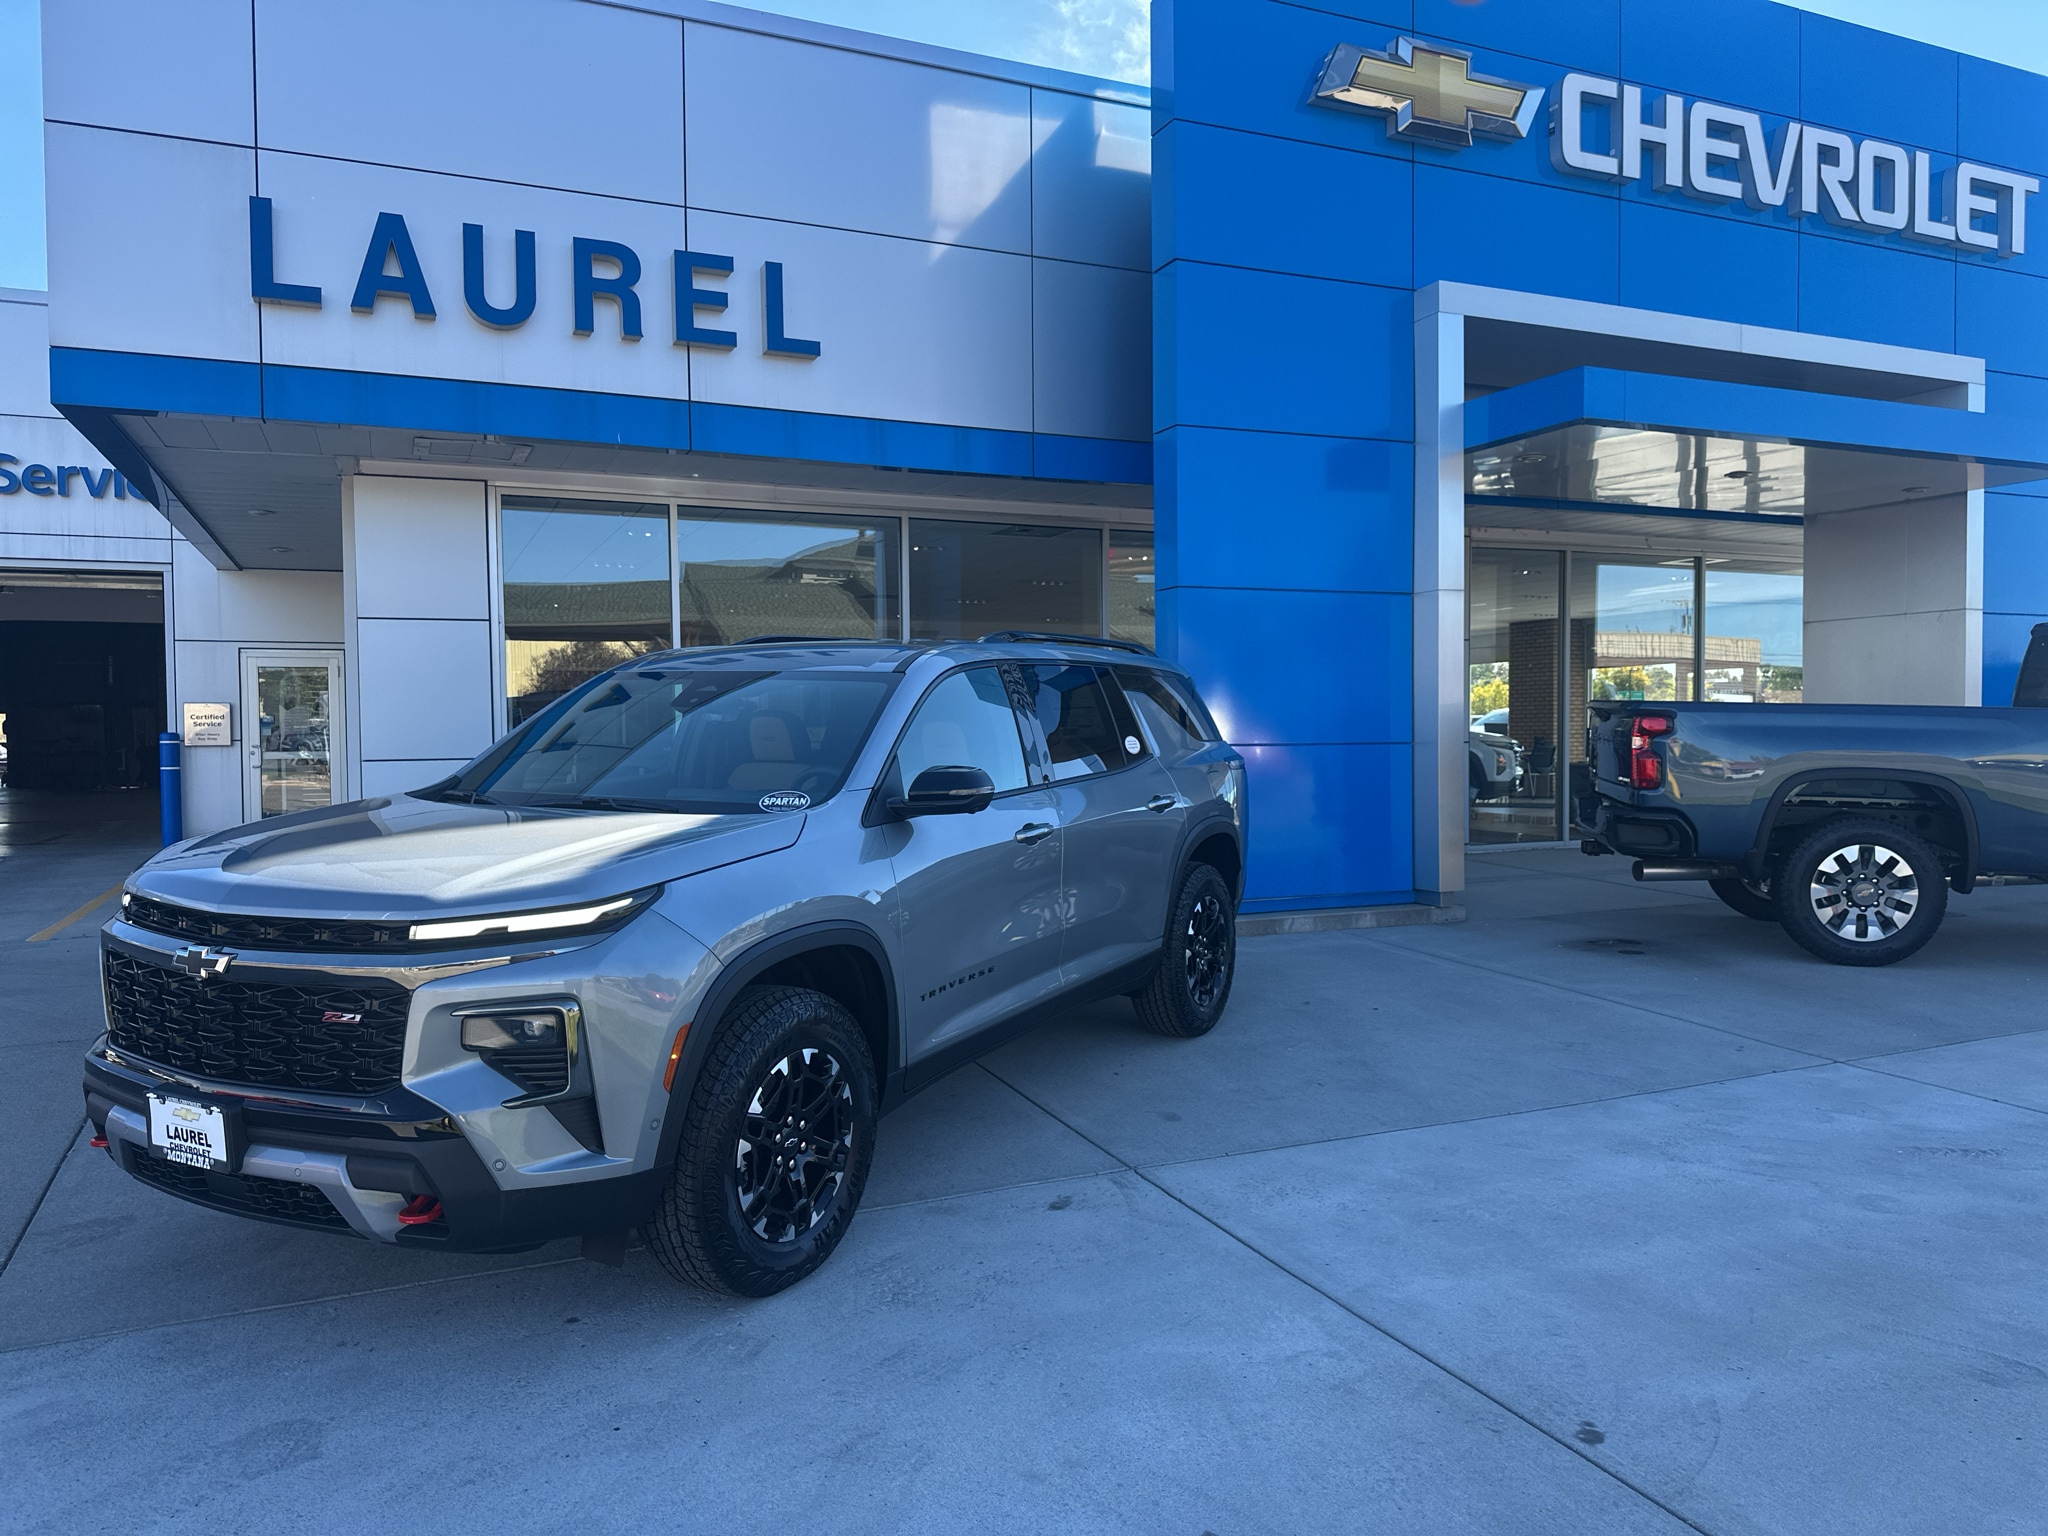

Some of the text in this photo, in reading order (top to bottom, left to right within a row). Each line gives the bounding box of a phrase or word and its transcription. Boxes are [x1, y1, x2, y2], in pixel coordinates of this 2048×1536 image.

[1553, 73, 2040, 257] CHEVROLET
[250, 196, 820, 359] LAUREL
[0, 452, 147, 501] Servi
[763, 797, 807, 806] SPARTAN
[920, 965, 995, 1002] TRAVERSE
[322, 1011, 362, 1024] Z71
[166, 1124, 212, 1148] LAUREL
[166, 1149, 211, 1170] MONTANA
[169, 1141, 211, 1158] CHEVROLET
